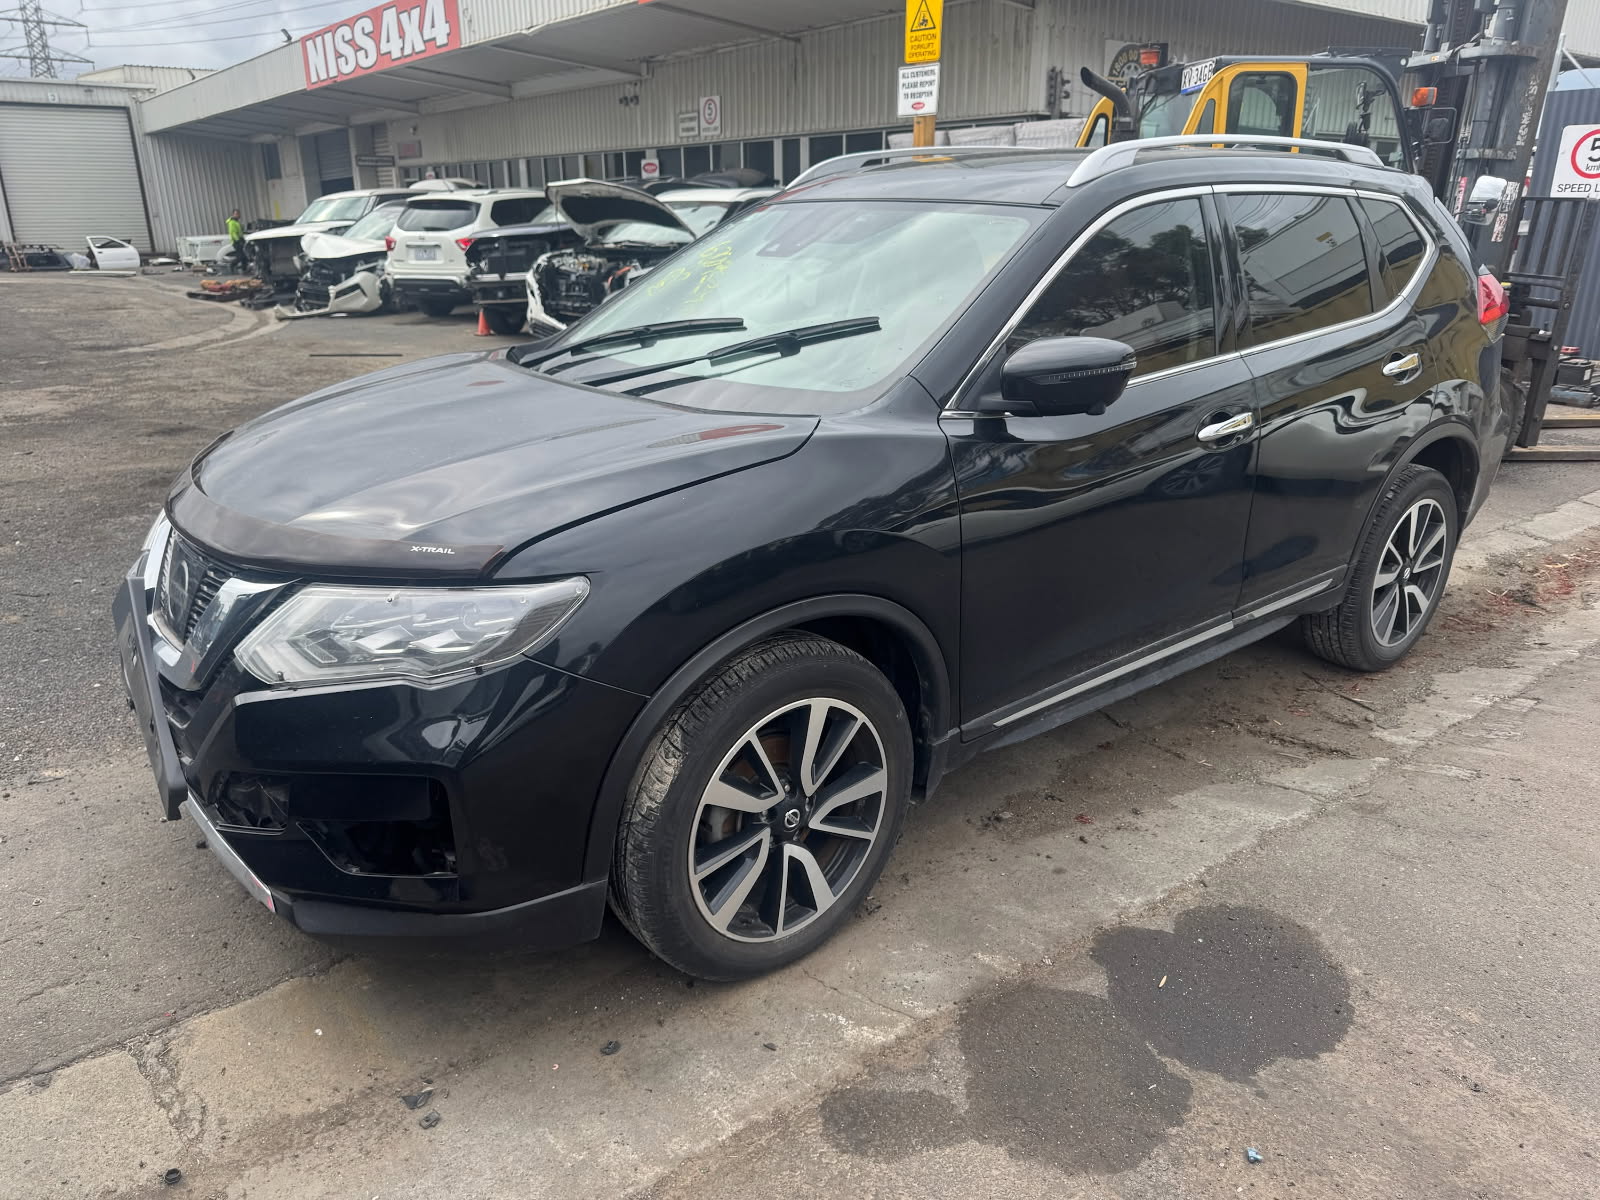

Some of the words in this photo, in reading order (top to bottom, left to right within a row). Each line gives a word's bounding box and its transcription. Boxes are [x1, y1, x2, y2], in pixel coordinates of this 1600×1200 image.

[910, 34, 936, 43] CAUTION
[911, 43, 934, 51] FORKLIFT
[707, 103, 713, 116] 5
[1557, 184, 1591, 192] SPEED
[410, 545, 456, 555] X-TRAIL
